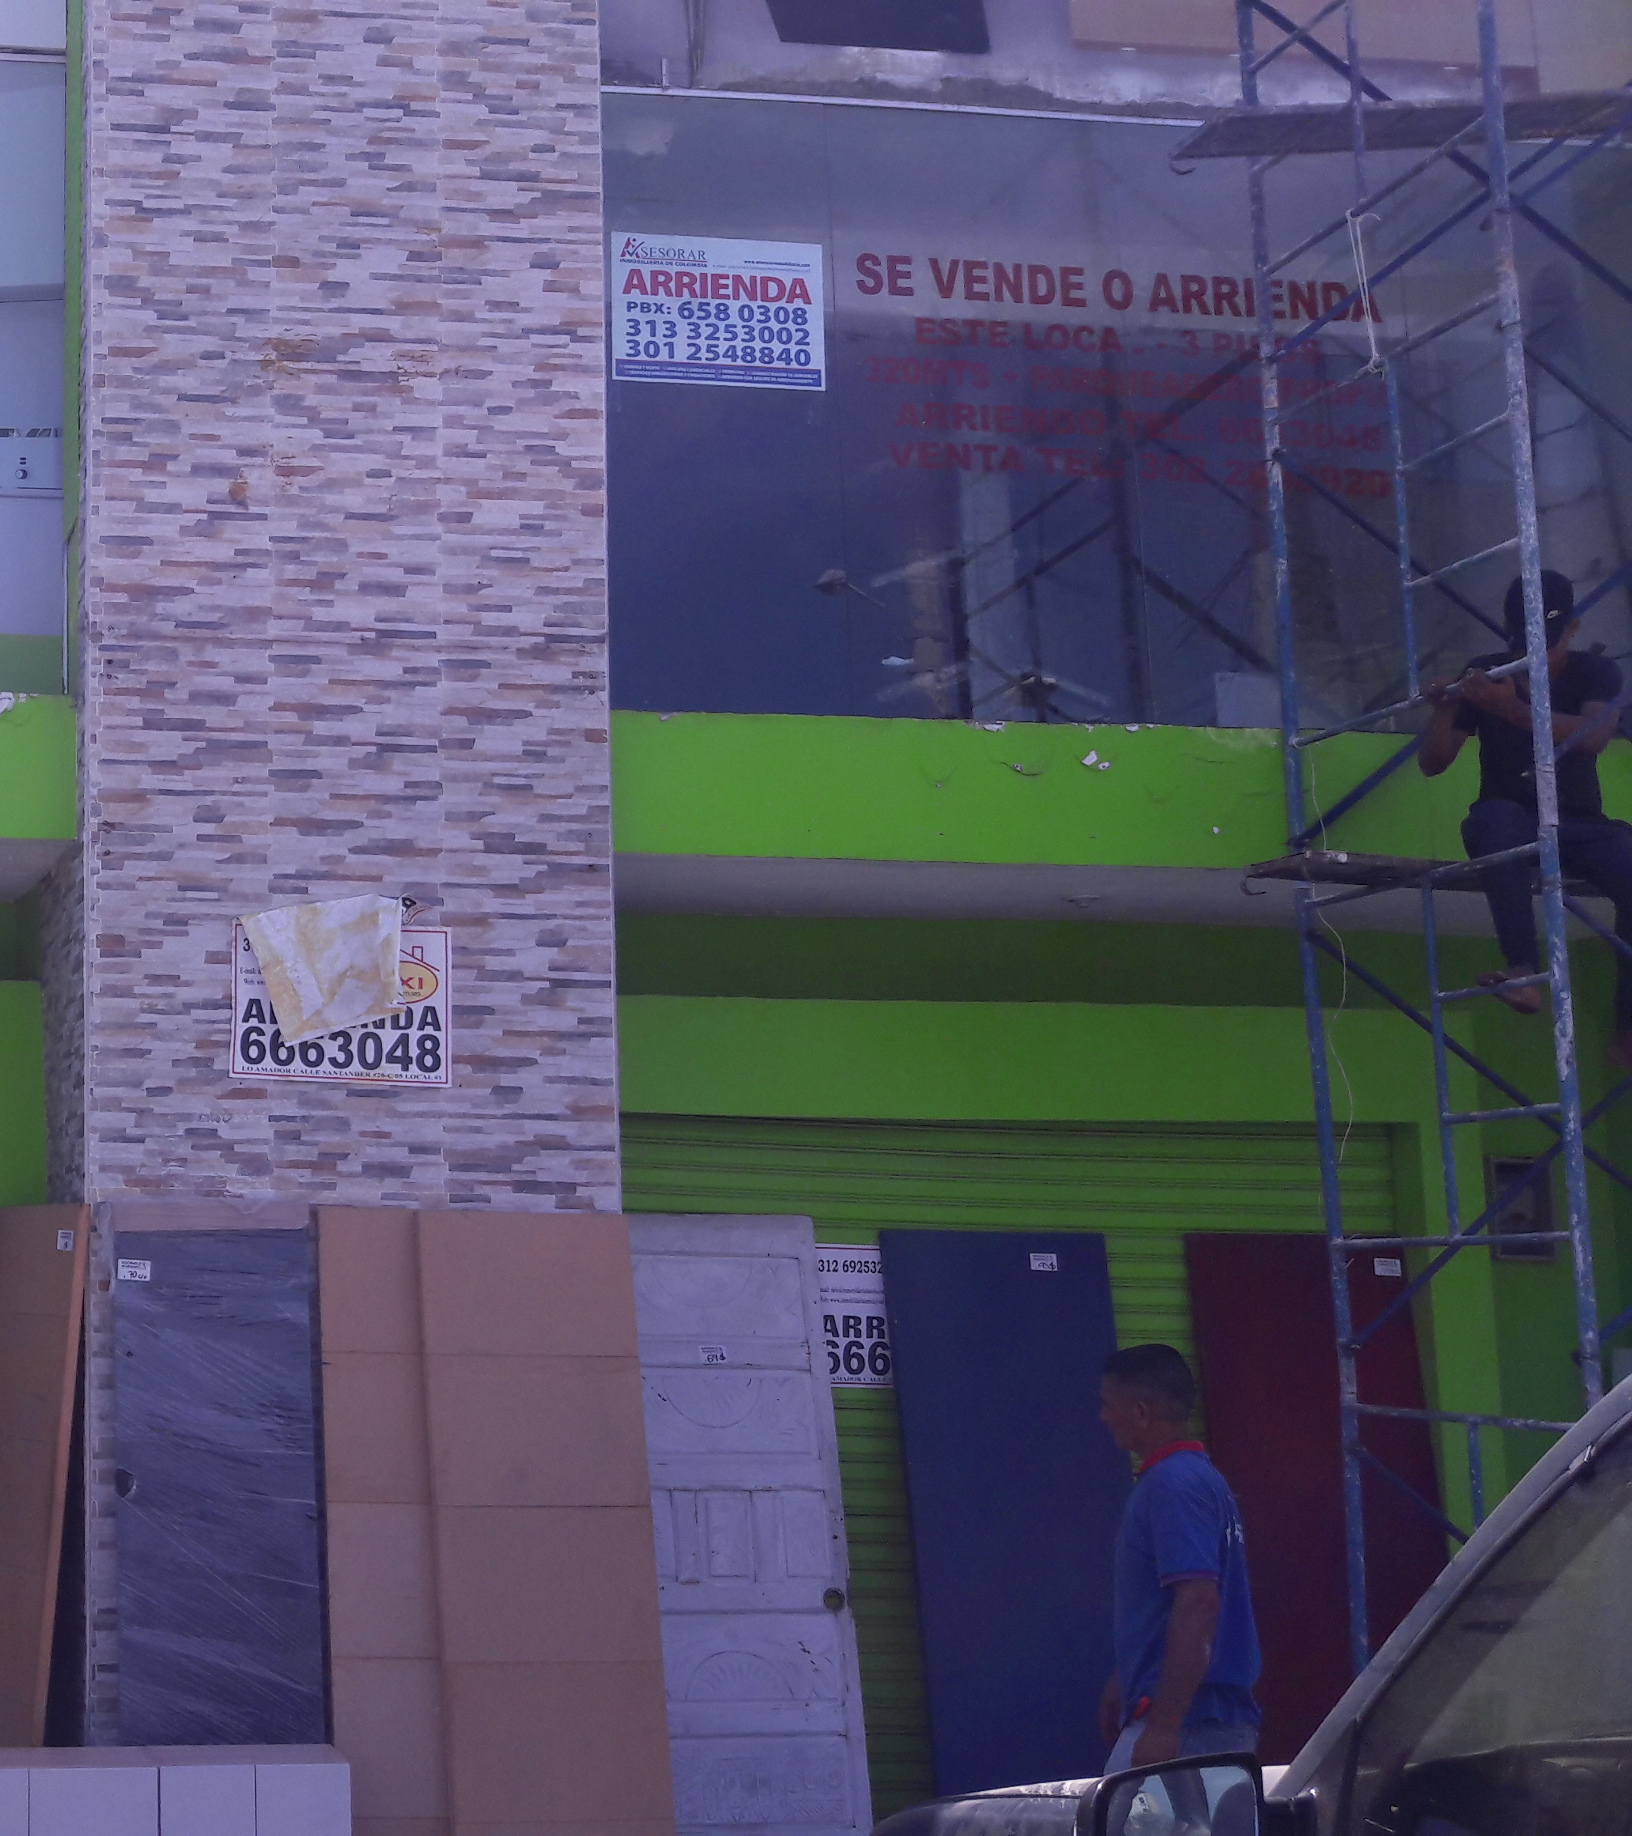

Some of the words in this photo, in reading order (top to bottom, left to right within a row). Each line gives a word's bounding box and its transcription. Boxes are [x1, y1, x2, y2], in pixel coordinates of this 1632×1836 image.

[622, 268, 812, 305] ARRIENDA
[856, 252, 915, 296] SE
[929, 257, 1087, 309] VENDE
[1102, 270, 1134, 310] O
[626, 301, 672, 315] PBX:
[677, 301, 730, 322] 658
[738, 304, 809, 326] 0308
[625, 318, 678, 339] 313
[686, 321, 810, 346] 3253002
[915, 317, 1010, 349] ESTE
[1180, 330, 1202, 358] 3
[625, 339, 675, 360] 301
[686, 342, 811, 367] 2548840
[864, 354, 991, 389] 320MTS
[895, 400, 1106, 436] ARRIENDO
[887, 440, 1025, 473] VENTA
[1139, 451, 1209, 483] 302
[240, 1026, 442, 1073] 6663048
[255, 1066, 291, 1074] AMADOR
[322, 1070, 371, 1078] SANTANDER
[818, 1259, 839, 1273] 312
